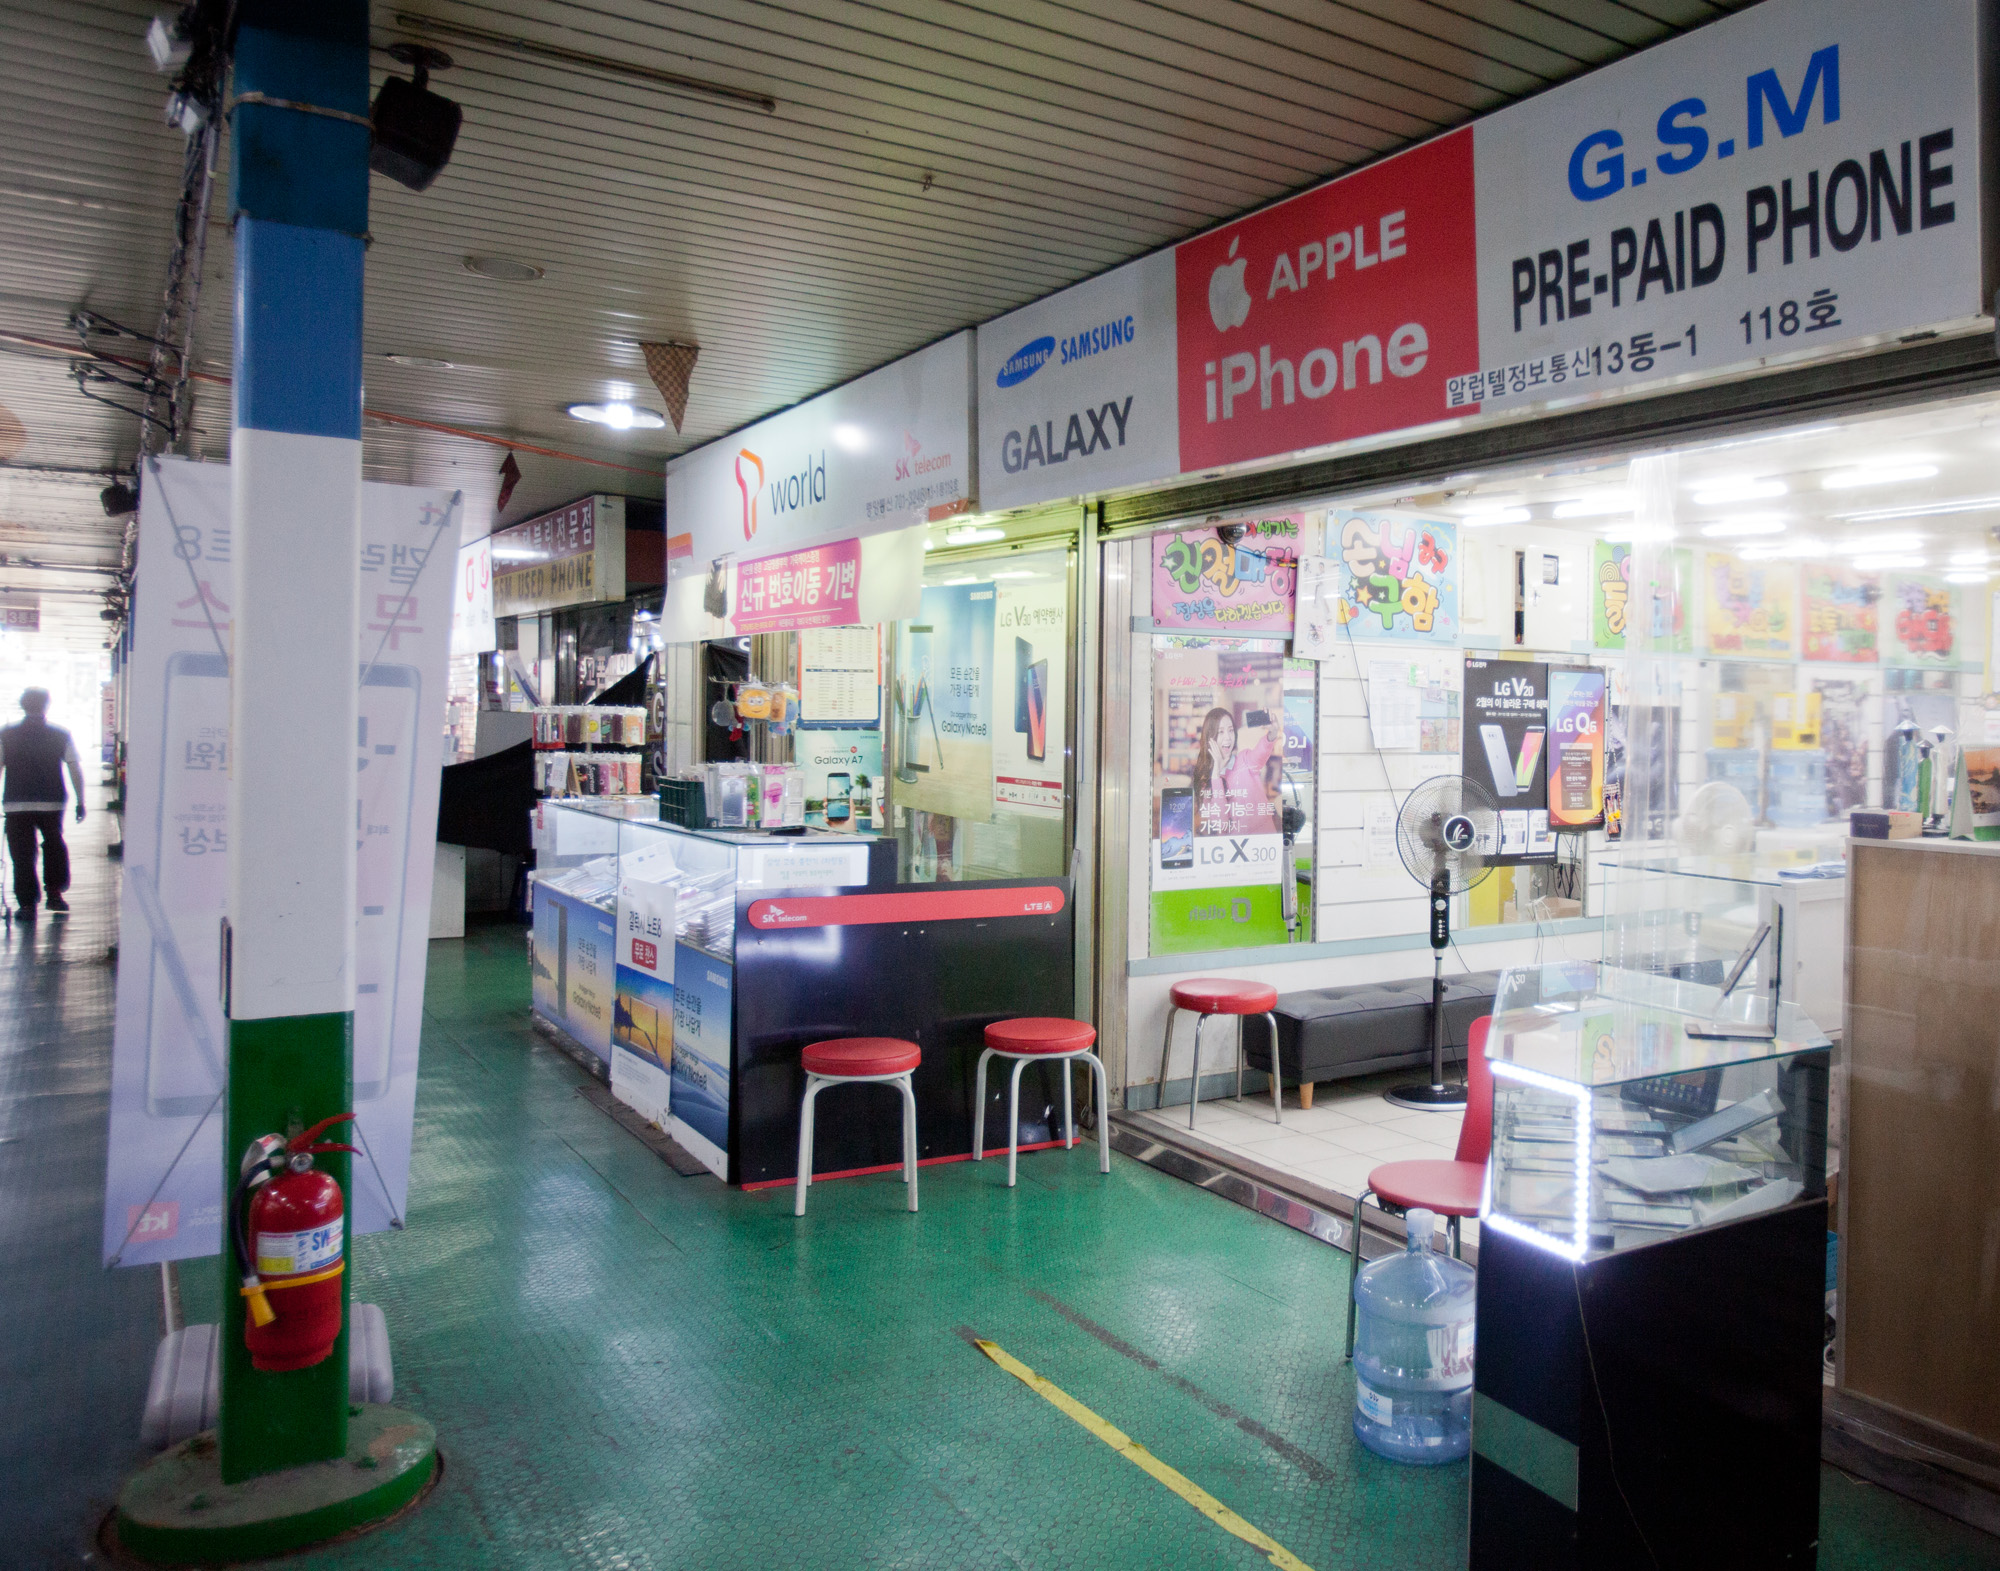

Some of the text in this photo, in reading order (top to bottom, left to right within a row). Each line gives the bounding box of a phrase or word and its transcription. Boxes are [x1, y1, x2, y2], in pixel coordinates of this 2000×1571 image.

[1567, 43, 1841, 202] G.S.M
[1512, 127, 1956, 332] PRE-PAID PHONE
[1267, 209, 1407, 301] APPLE
[1002, 314, 1135, 376] SAMSUNG SAMSUNG
[1448, 346, 1590, 406] 알럽텔정보통신
[1740, 288, 1843, 345] 118호
[1205, 321, 1429, 424] iPhone
[1001, 395, 1134, 474] GALAXY
[770, 449, 826, 516] world
[895, 452, 951, 481] SK telecom
[518, 568, 544, 600] USED
[551, 554, 592, 594] PHONE
[741, 560, 856, 613] 신규 번호이동 기변
[970, 590, 994, 601] SAMSUNG
[1000, 612, 1012, 628] LG
[1172, 597, 1286, 622] 정성을 다하겠습니다
[1369, 570, 1440, 632] 구함
[1494, 677, 1534, 697] LG V20
[1556, 712, 1598, 736] LG Q6
[814, 755, 864, 768] Galaxy A7
[1199, 802, 1276, 818] 실속 기능은 물론
[1200, 846, 1224, 865] LG
[762, 914, 775, 923] SK
[778, 914, 807, 923] telecom
[1024, 902, 1043, 911] LTE
